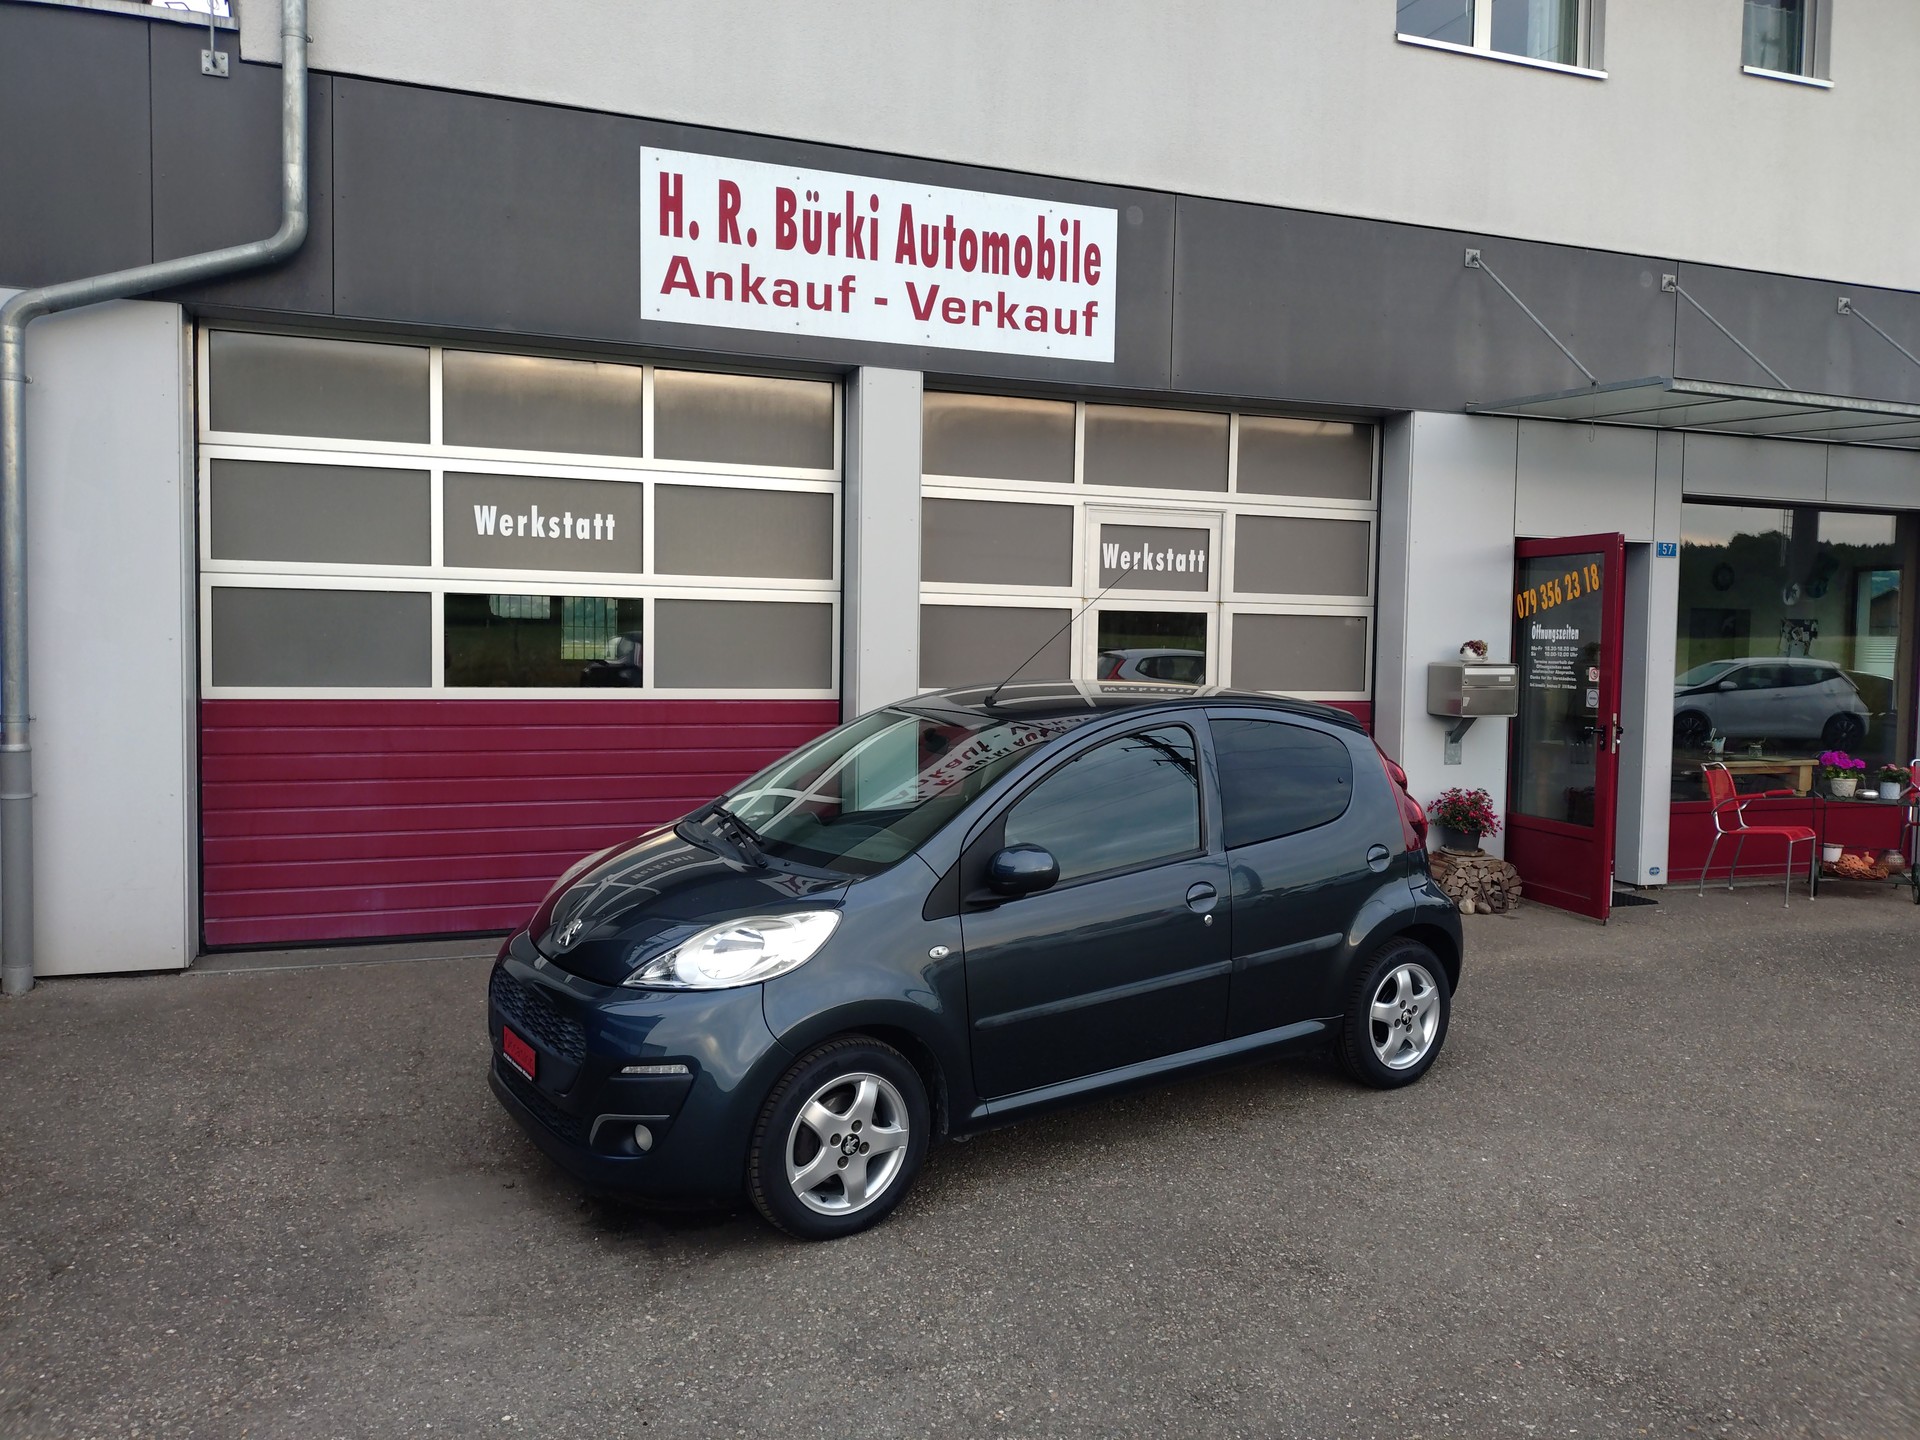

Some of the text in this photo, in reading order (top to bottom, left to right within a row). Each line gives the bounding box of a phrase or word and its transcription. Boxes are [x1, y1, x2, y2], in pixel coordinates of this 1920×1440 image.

[658, 171, 1102, 287] H. R. Bürki Automobile
[660, 254, 857, 314] Ankauf
[904, 281, 1099, 337] Verkauf
[473, 504, 616, 541] Werkstatt
[1102, 542, 1205, 573] Werkstatt
[1662, 543, 1673, 555] 57
[1516, 563, 1600, 619] 079 356 23 18
[1531, 621, 1579, 643] Öffnungszeiten
